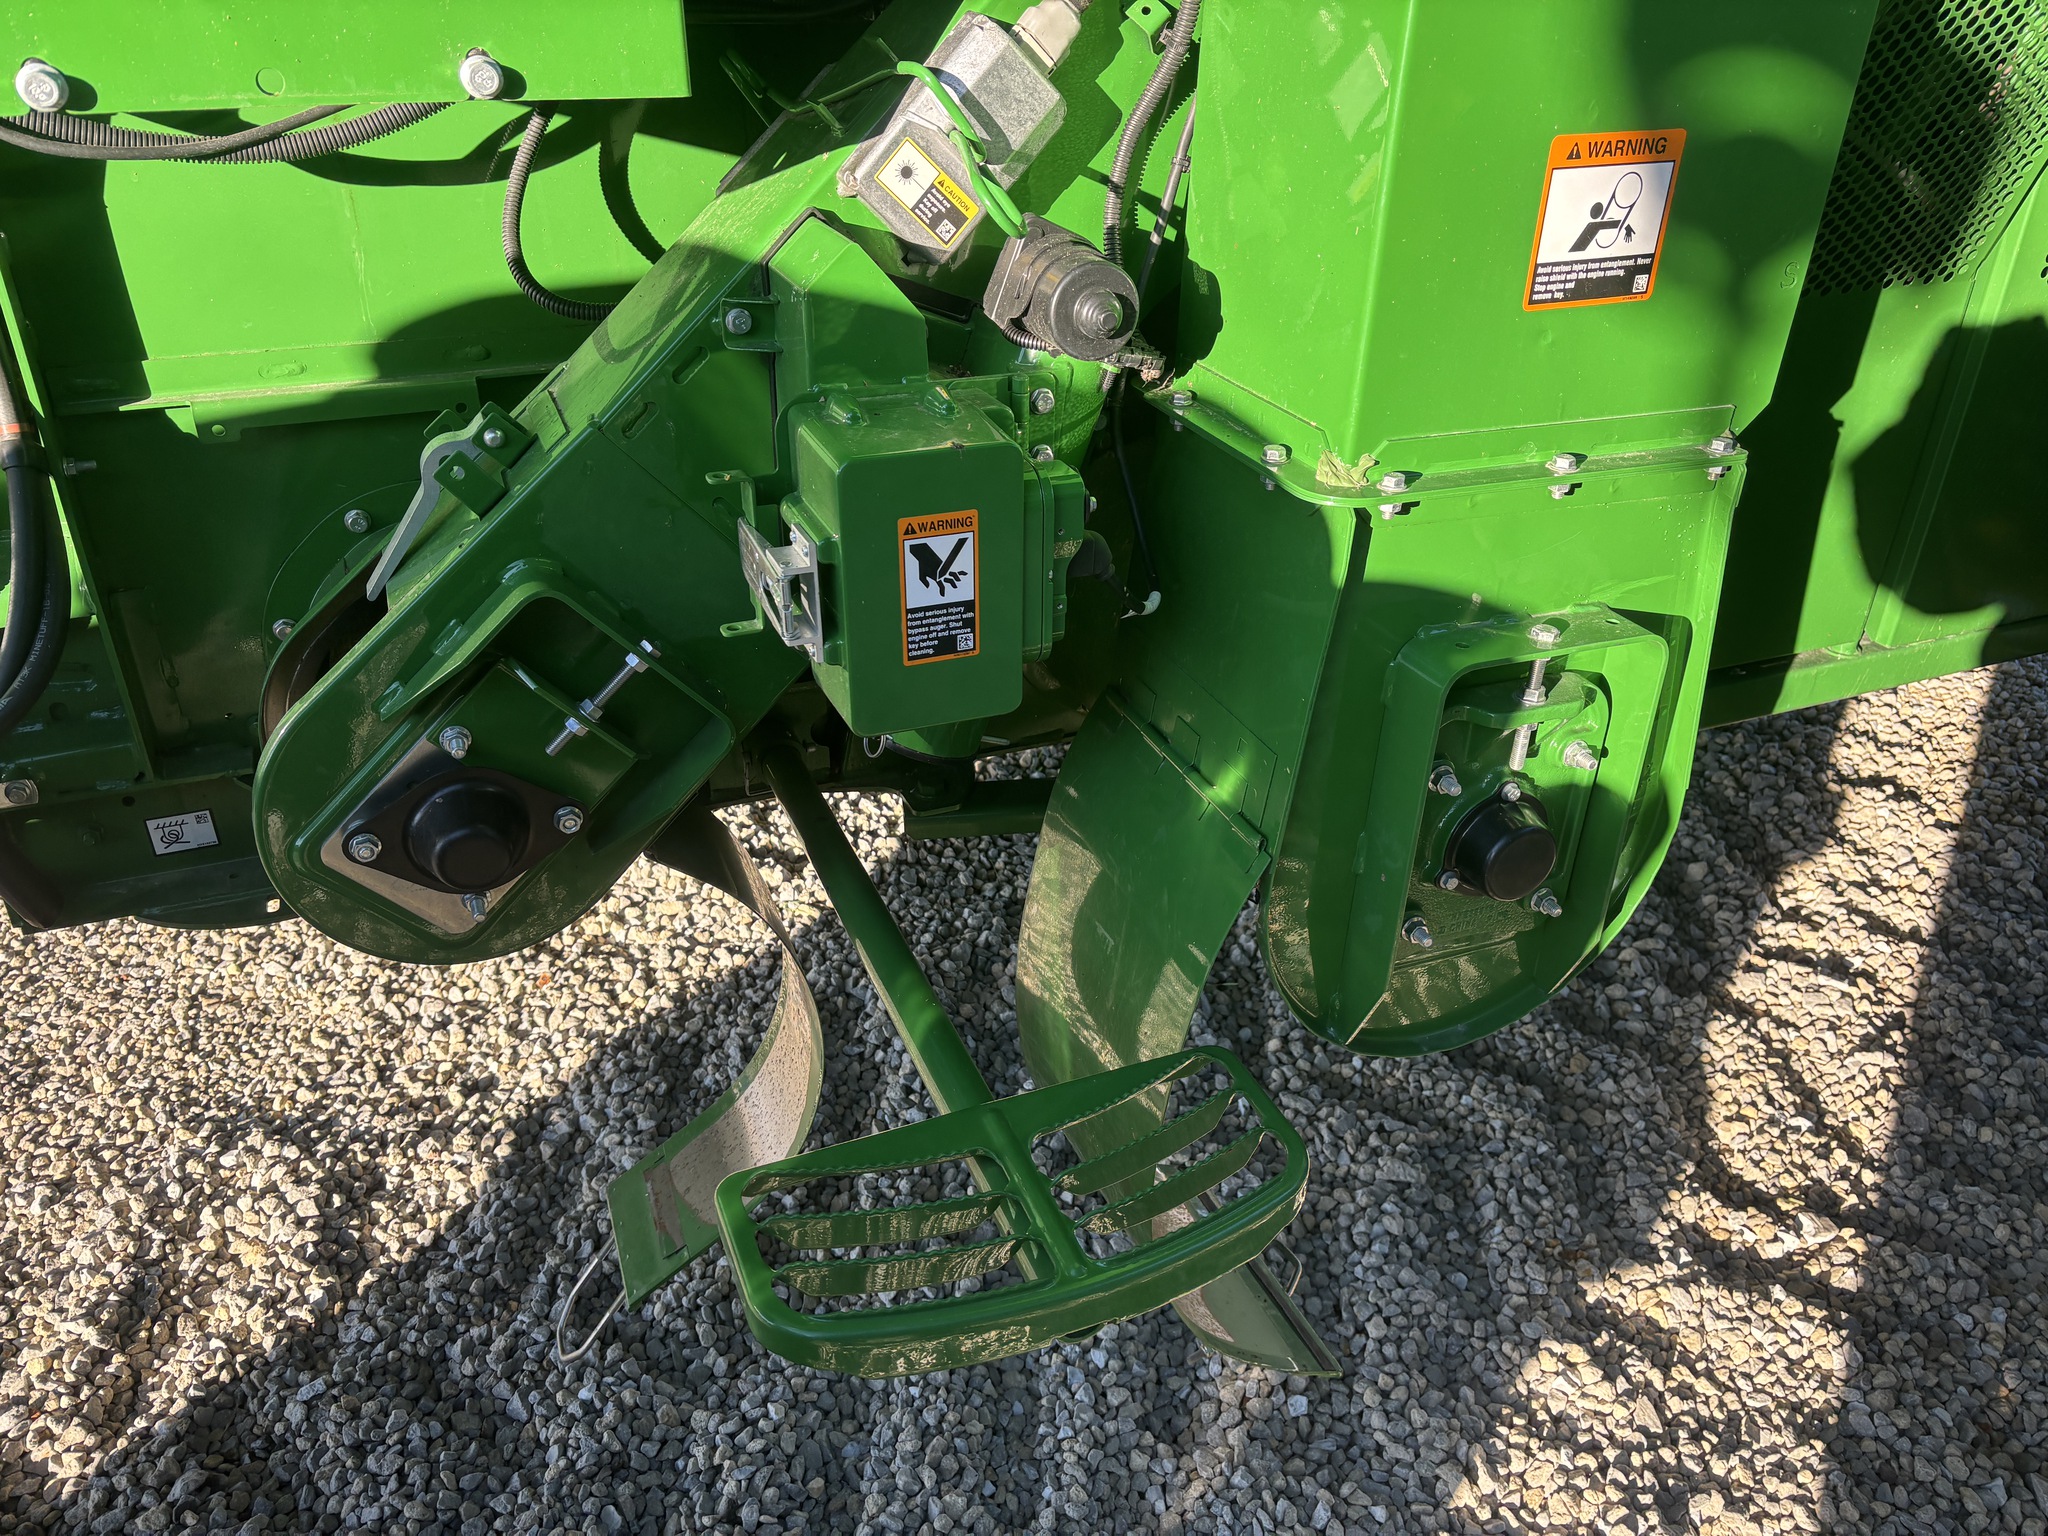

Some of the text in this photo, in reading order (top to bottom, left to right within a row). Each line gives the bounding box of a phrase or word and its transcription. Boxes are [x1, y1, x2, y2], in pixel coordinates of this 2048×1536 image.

[1588, 137, 1668, 158] WARNING
[923, 197, 932, 208] Key
[931, 188, 951, 208] Avoid eye
[944, 185, 970, 212] CAUTION
[914, 208, 930, 225] service.
[918, 203, 933, 218] during
[1536, 257, 1652, 274] Avoid serious injury from entanglement. Never
[1535, 268, 1626, 283] raise shield with the engine running.
[1533, 281, 1576, 292] Stop engine and
[1532, 291, 1565, 300] remove key.
[918, 516, 974, 533] WARNING
[907, 611, 925, 619] Avoid
[925, 608, 947, 616] serious
[922, 614, 962, 624] entanglement
[908, 626, 929, 635] bypass
[930, 624, 948, 632] auger.
[908, 634, 928, 642] engine
[908, 648, 935, 657] cleaning.
